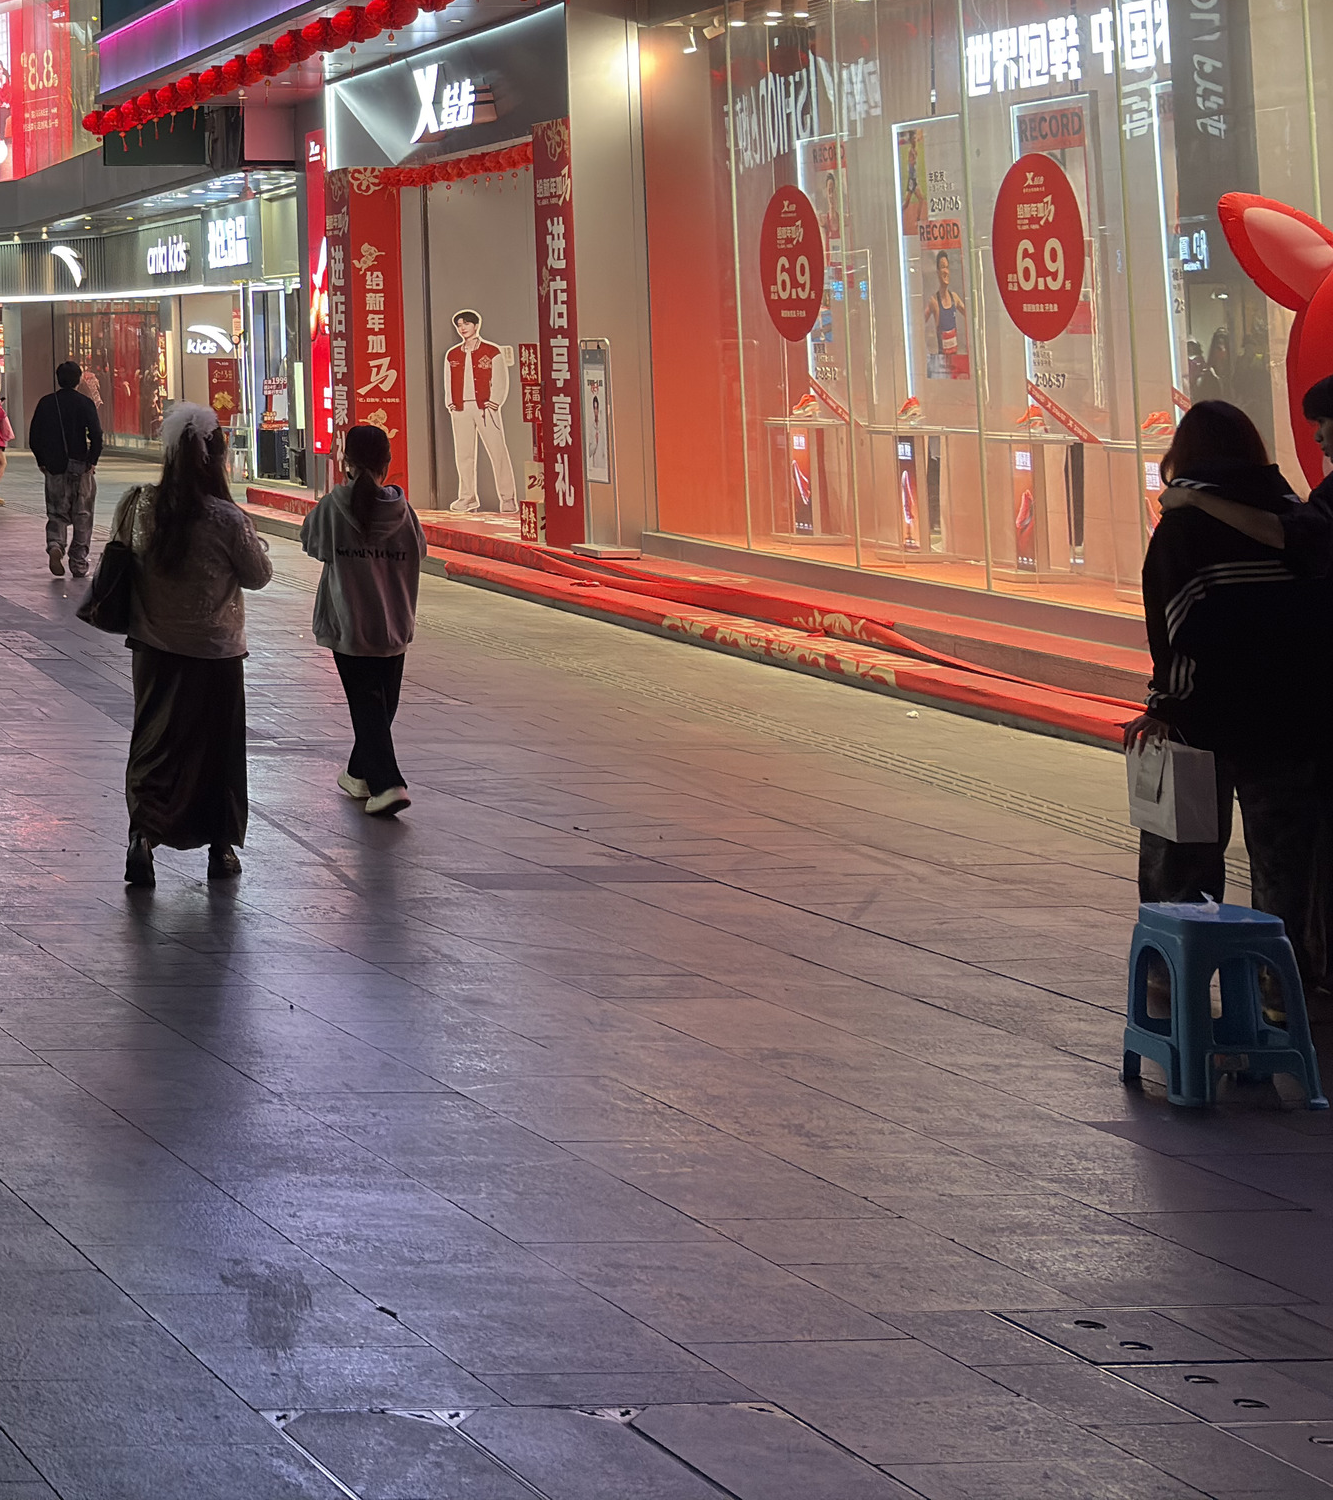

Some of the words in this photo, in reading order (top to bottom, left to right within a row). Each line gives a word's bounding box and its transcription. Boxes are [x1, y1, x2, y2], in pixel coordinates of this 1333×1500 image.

[964, 12, 1082, 100] 世界跑鞋
[1019, 111, 1082, 143] RECORD
[930, 196, 961, 213] 2:07:06
[919, 222, 960, 242] RECORD
[146, 243, 166, 275] anta
[167, 236, 191, 274] kids
[1016, 238, 1065, 291] 6.9
[776, 255, 811, 300] 6.9
[186, 338, 218, 354] kids
[357, 271, 398, 396] 给新年加马
[545, 216, 575, 508] 进店享豪礼
[1033, 372, 1067, 389] 2:06:57
